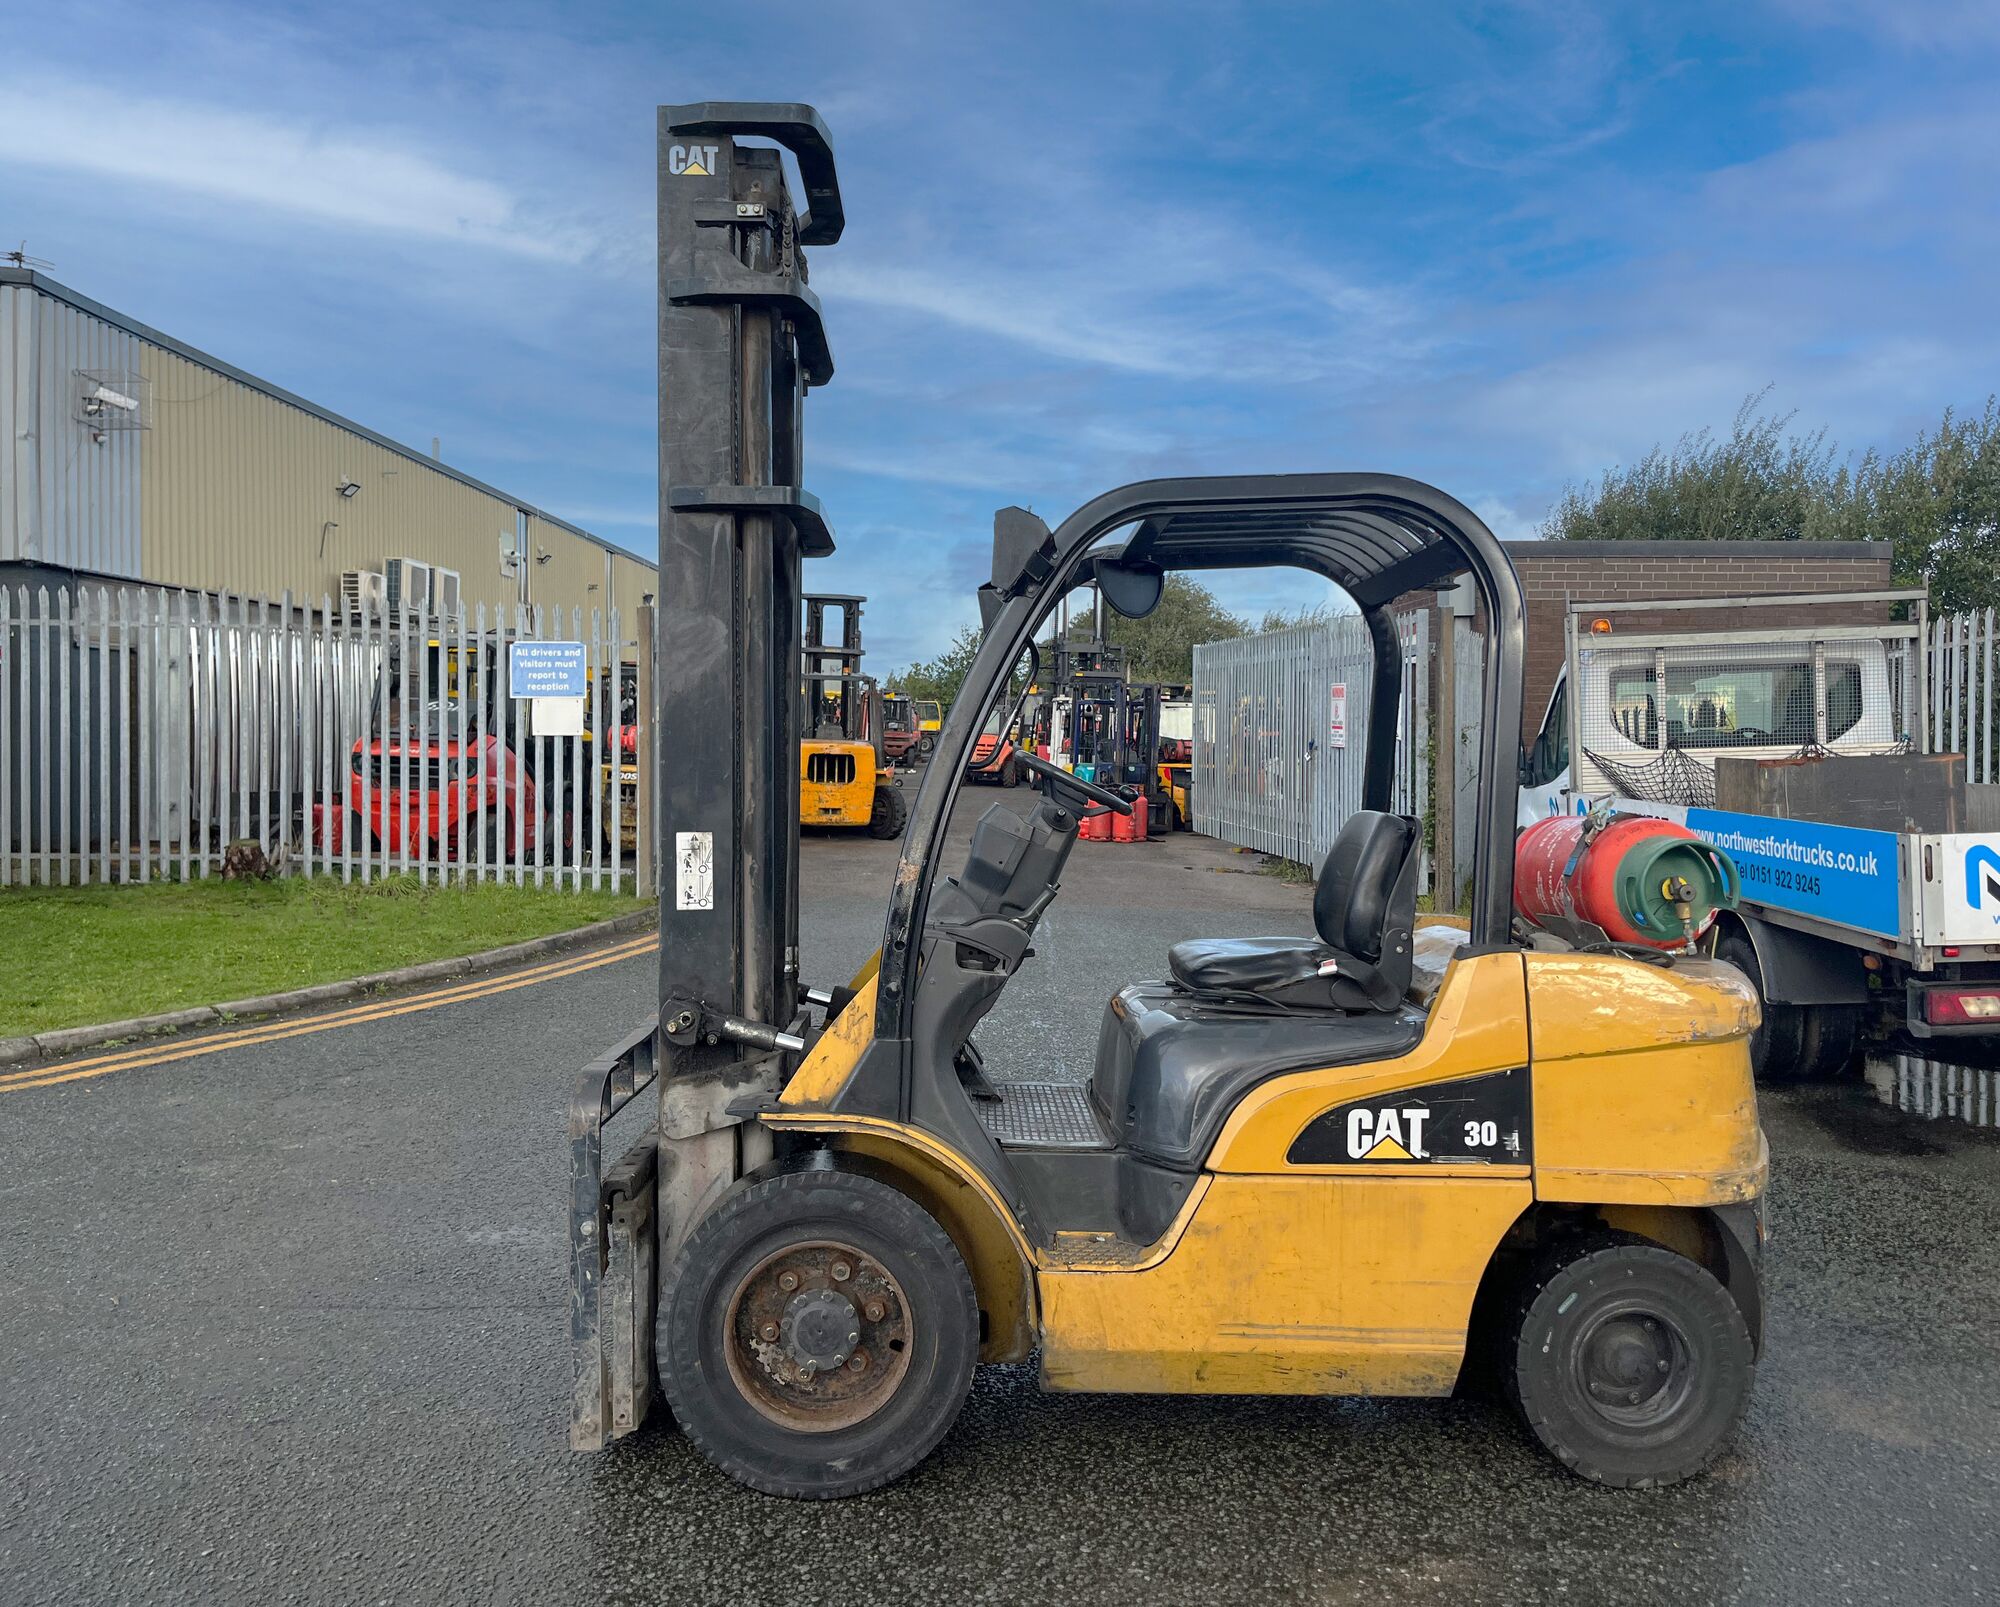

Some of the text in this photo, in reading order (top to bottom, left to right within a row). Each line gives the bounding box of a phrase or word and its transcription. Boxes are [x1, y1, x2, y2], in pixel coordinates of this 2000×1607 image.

[669, 145, 719, 175] CAT
[516, 648, 581, 657] All drivers and
[519, 660, 577, 668] visitors must
[528, 672, 556, 680] report
[527, 683, 569, 691] reception
[1689, 827, 1878, 876] ww.northwestforktrucks.co.uk
[1734, 861, 1820, 896] Tel 0151 922 9245
[1347, 1108, 1497, 1159] CAT 30
